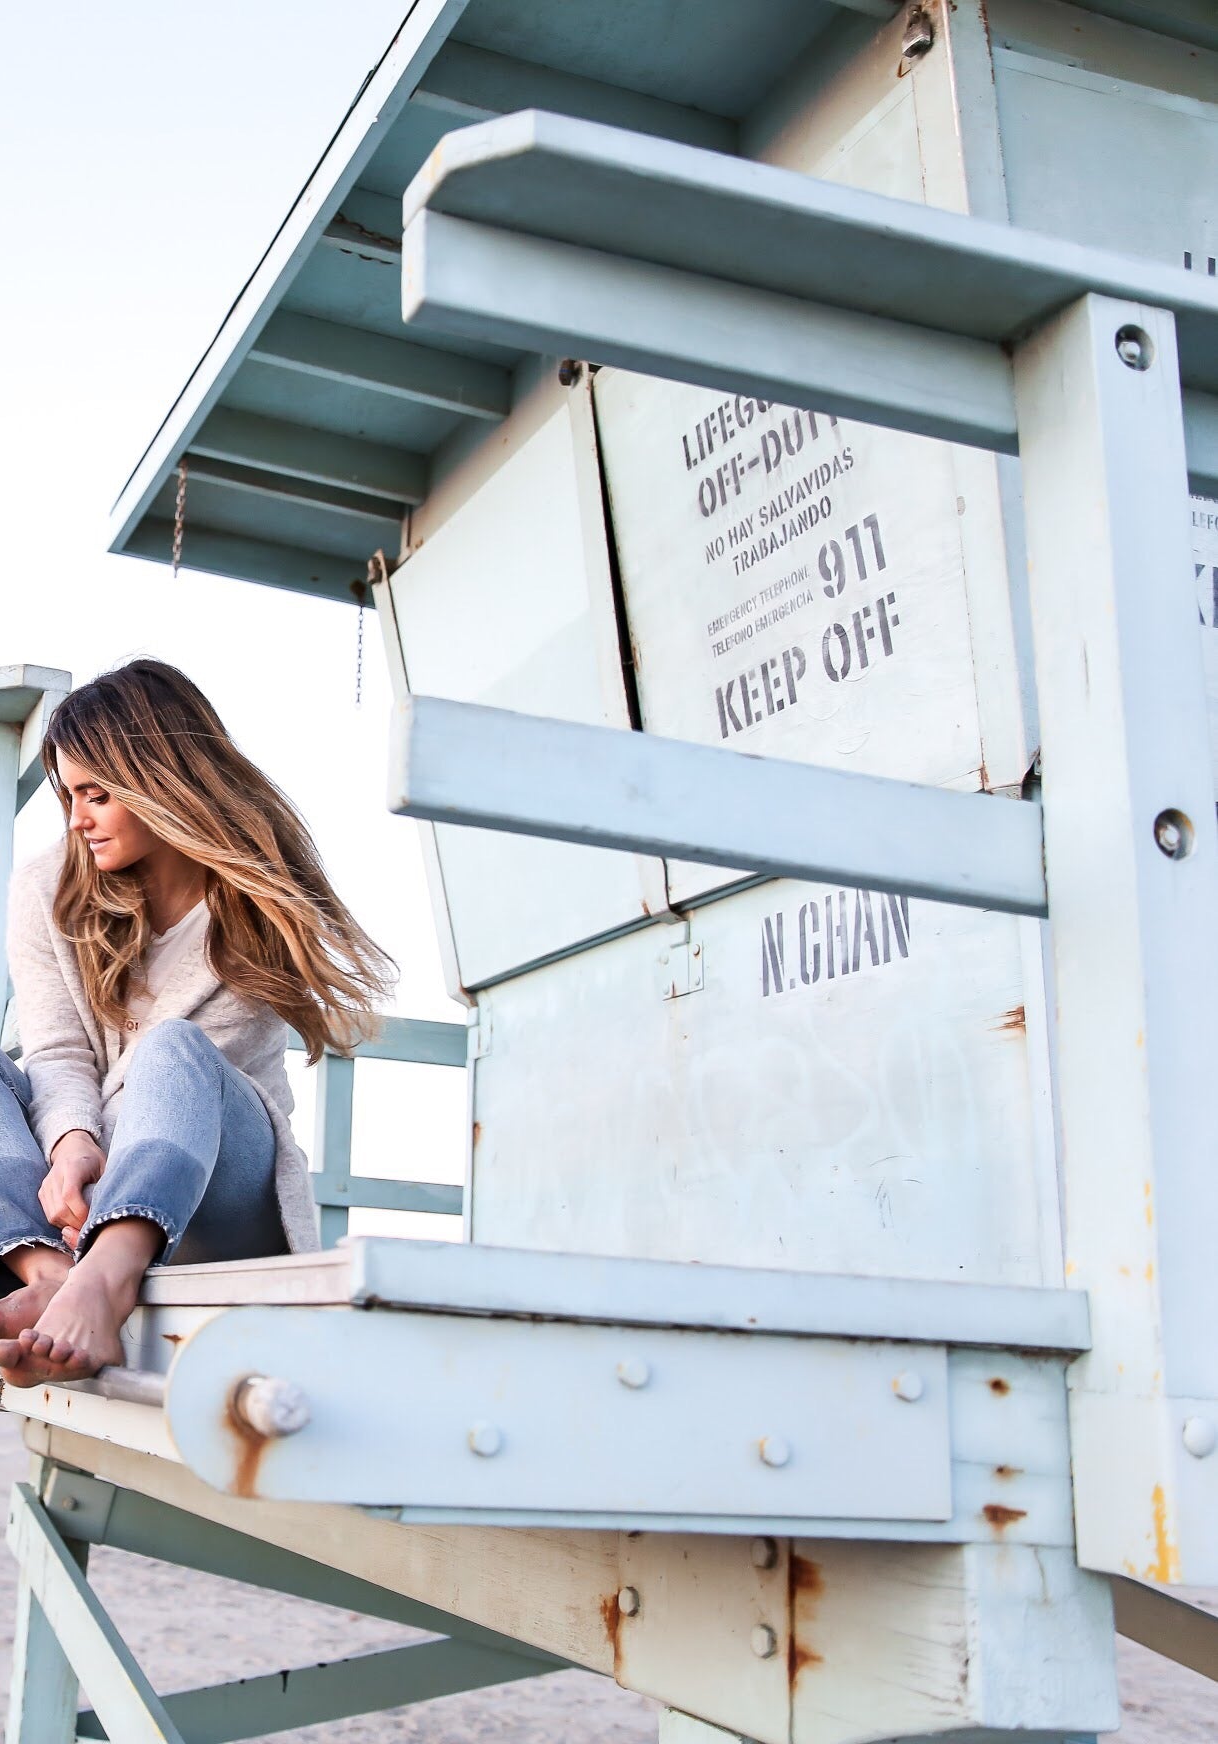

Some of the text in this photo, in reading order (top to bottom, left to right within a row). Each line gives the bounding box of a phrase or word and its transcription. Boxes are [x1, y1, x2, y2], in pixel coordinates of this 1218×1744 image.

[705, 447, 854, 565] NO HAY SALVAVIDAS
[732, 495, 832, 576] TRABAJANDO
[818, 511, 887, 599] 911
[707, 595, 757, 637] EMERGENCY
[712, 588, 814, 658] TELEFONO EMERGENCIA
[715, 591, 900, 739] KEEP OFF
